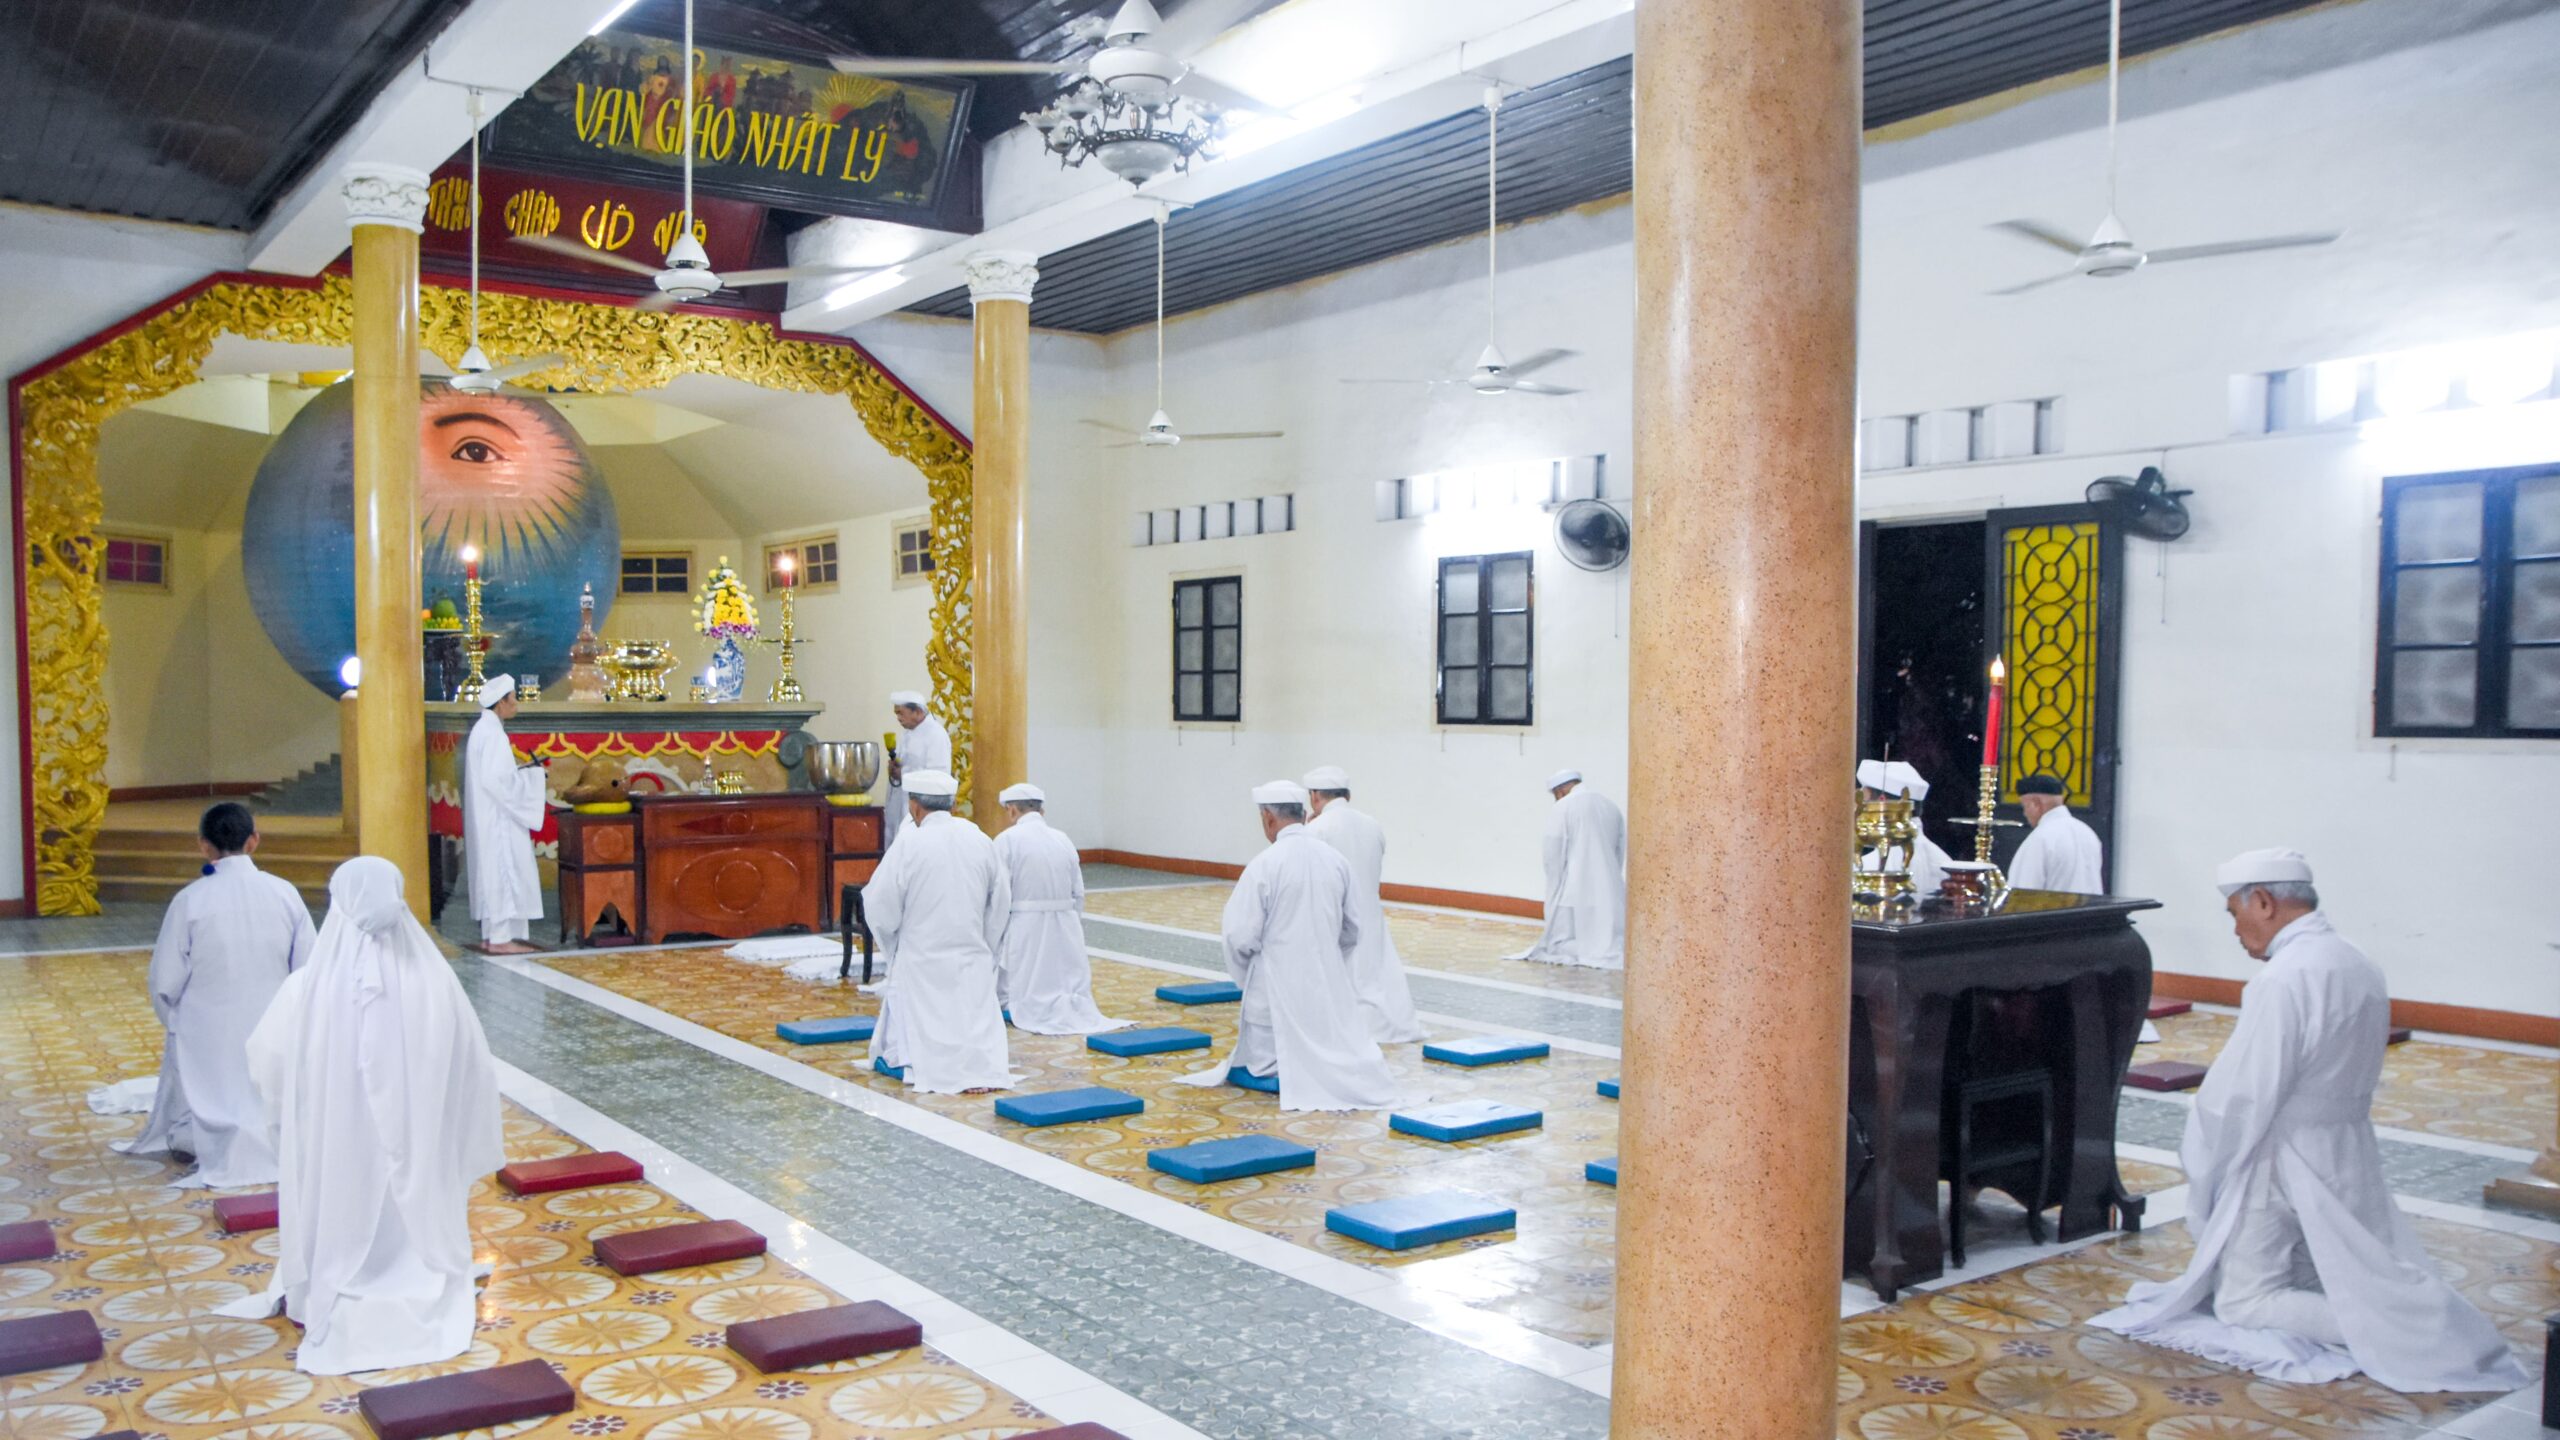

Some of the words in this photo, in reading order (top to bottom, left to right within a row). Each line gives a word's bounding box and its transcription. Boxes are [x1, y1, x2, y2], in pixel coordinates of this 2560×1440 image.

[575, 82, 646, 148] VẠN
[655, 95, 736, 161] GIÁO
[739, 111, 841, 177] NHẤT
[840, 124, 888, 183] LÝ
